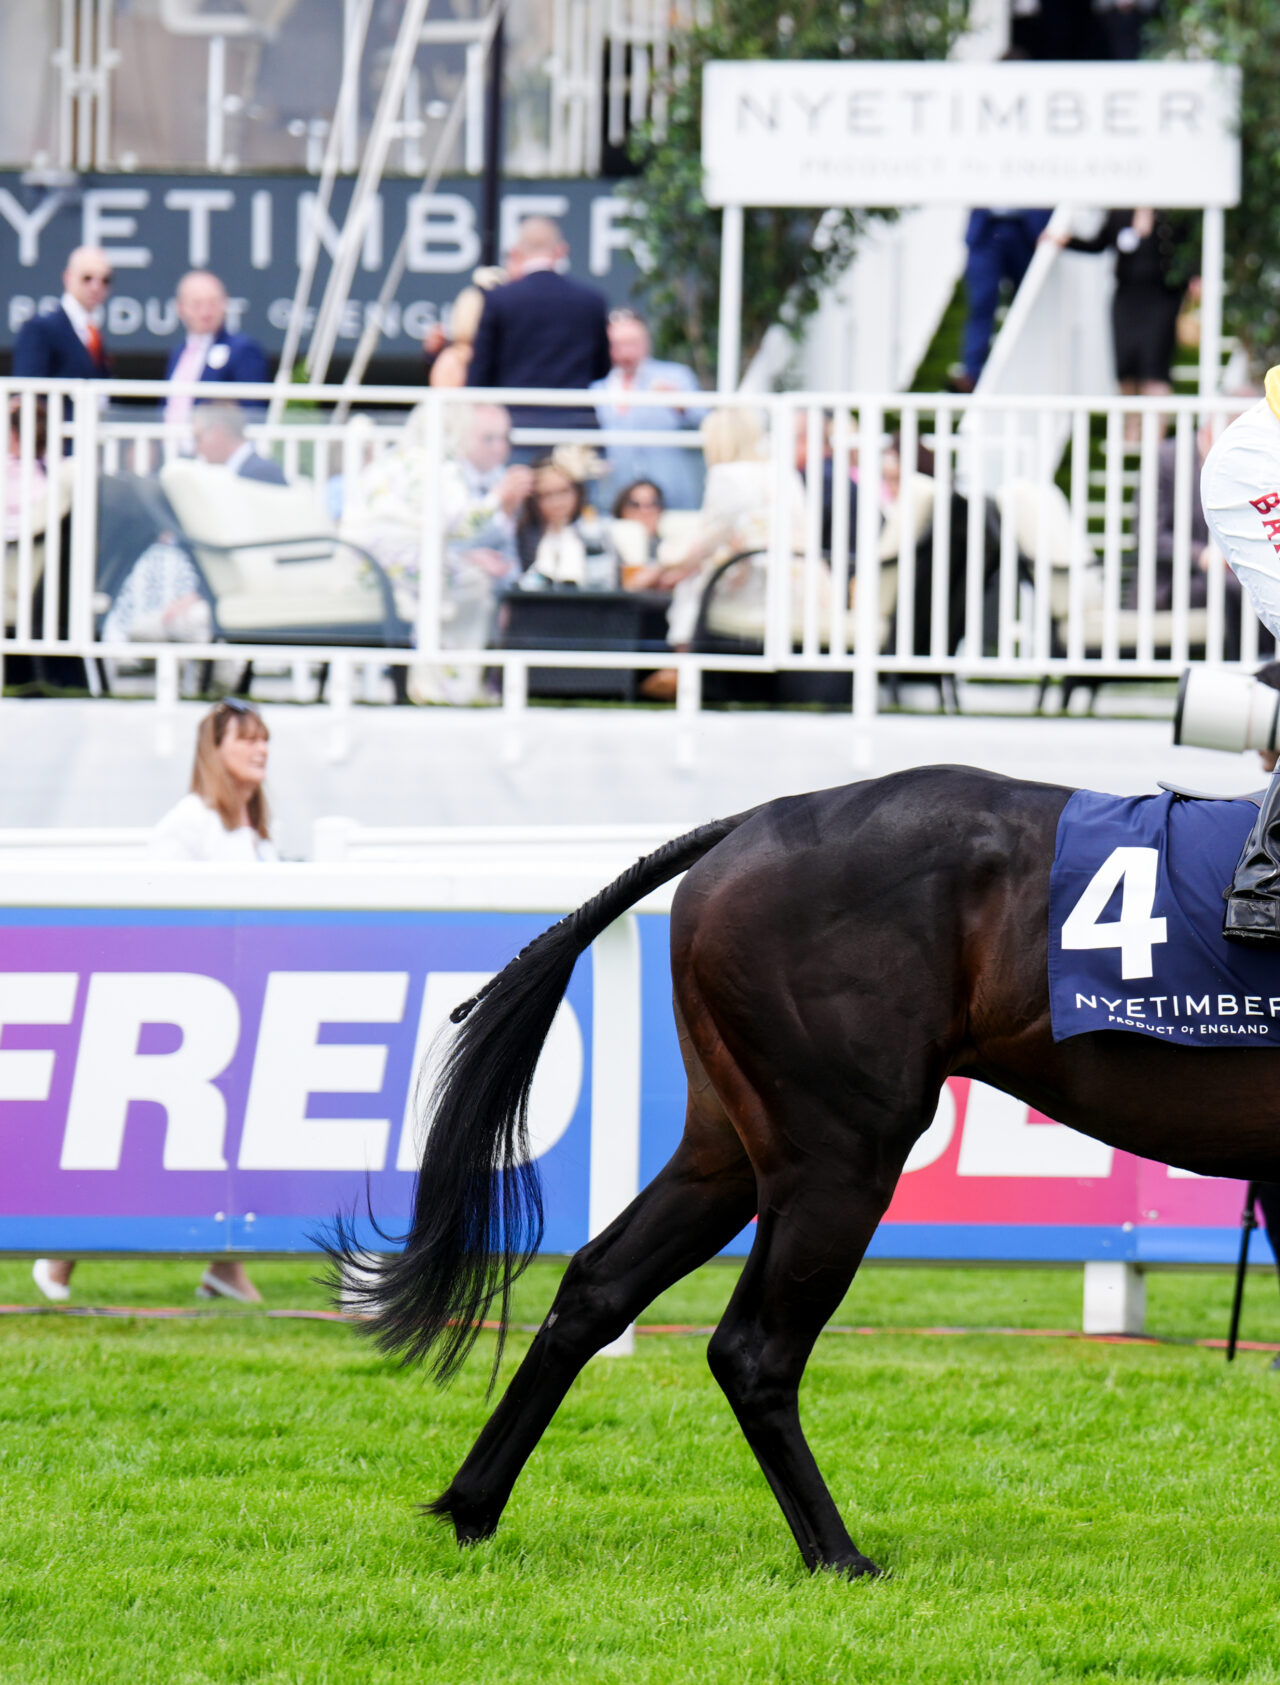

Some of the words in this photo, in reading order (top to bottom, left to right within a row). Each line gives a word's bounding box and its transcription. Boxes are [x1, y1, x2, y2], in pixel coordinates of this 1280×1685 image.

[736, 90, 1206, 138] NYETIMBER
[8, 295, 250, 336] PDUT
[1061, 846, 1168, 980] 4
[1108, 1015, 1174, 1035] PRODUCT
[1200, 1024, 1269, 1035] ENGLAND
